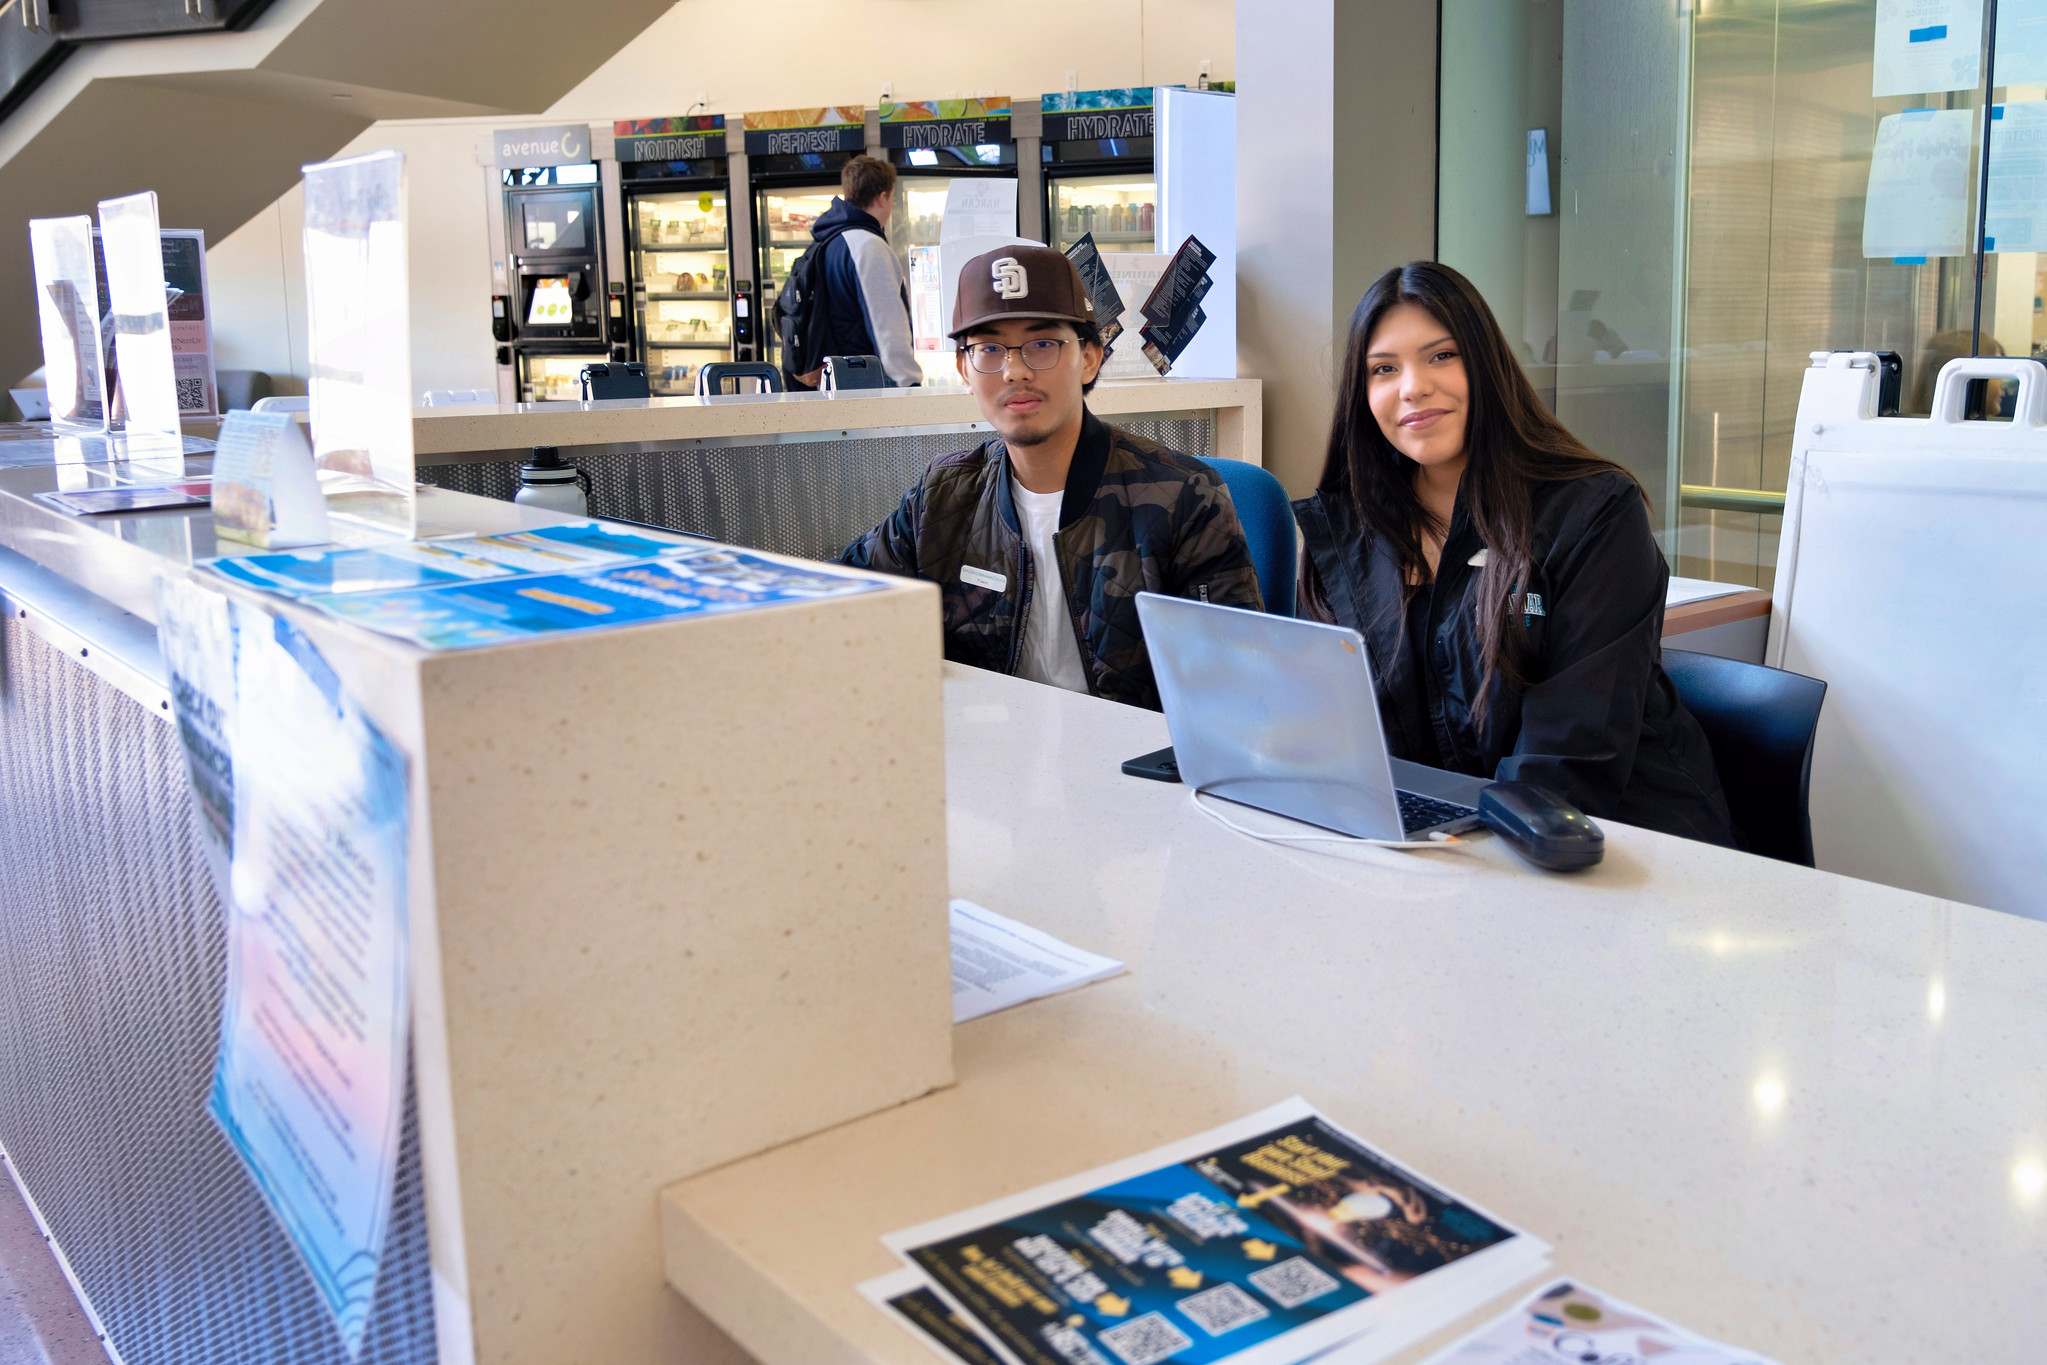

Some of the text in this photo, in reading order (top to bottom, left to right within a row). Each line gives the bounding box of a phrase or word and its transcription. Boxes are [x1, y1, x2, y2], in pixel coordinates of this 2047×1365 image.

[903, 122, 985, 148] HYDRATE
[1068, 113, 1154, 140] HYDRATE
[502, 139, 558, 157] avenue
[634, 137, 706, 161] NOURISH
[768, 130, 840, 155] REFRESH
[992, 257, 1029, 300] SD
